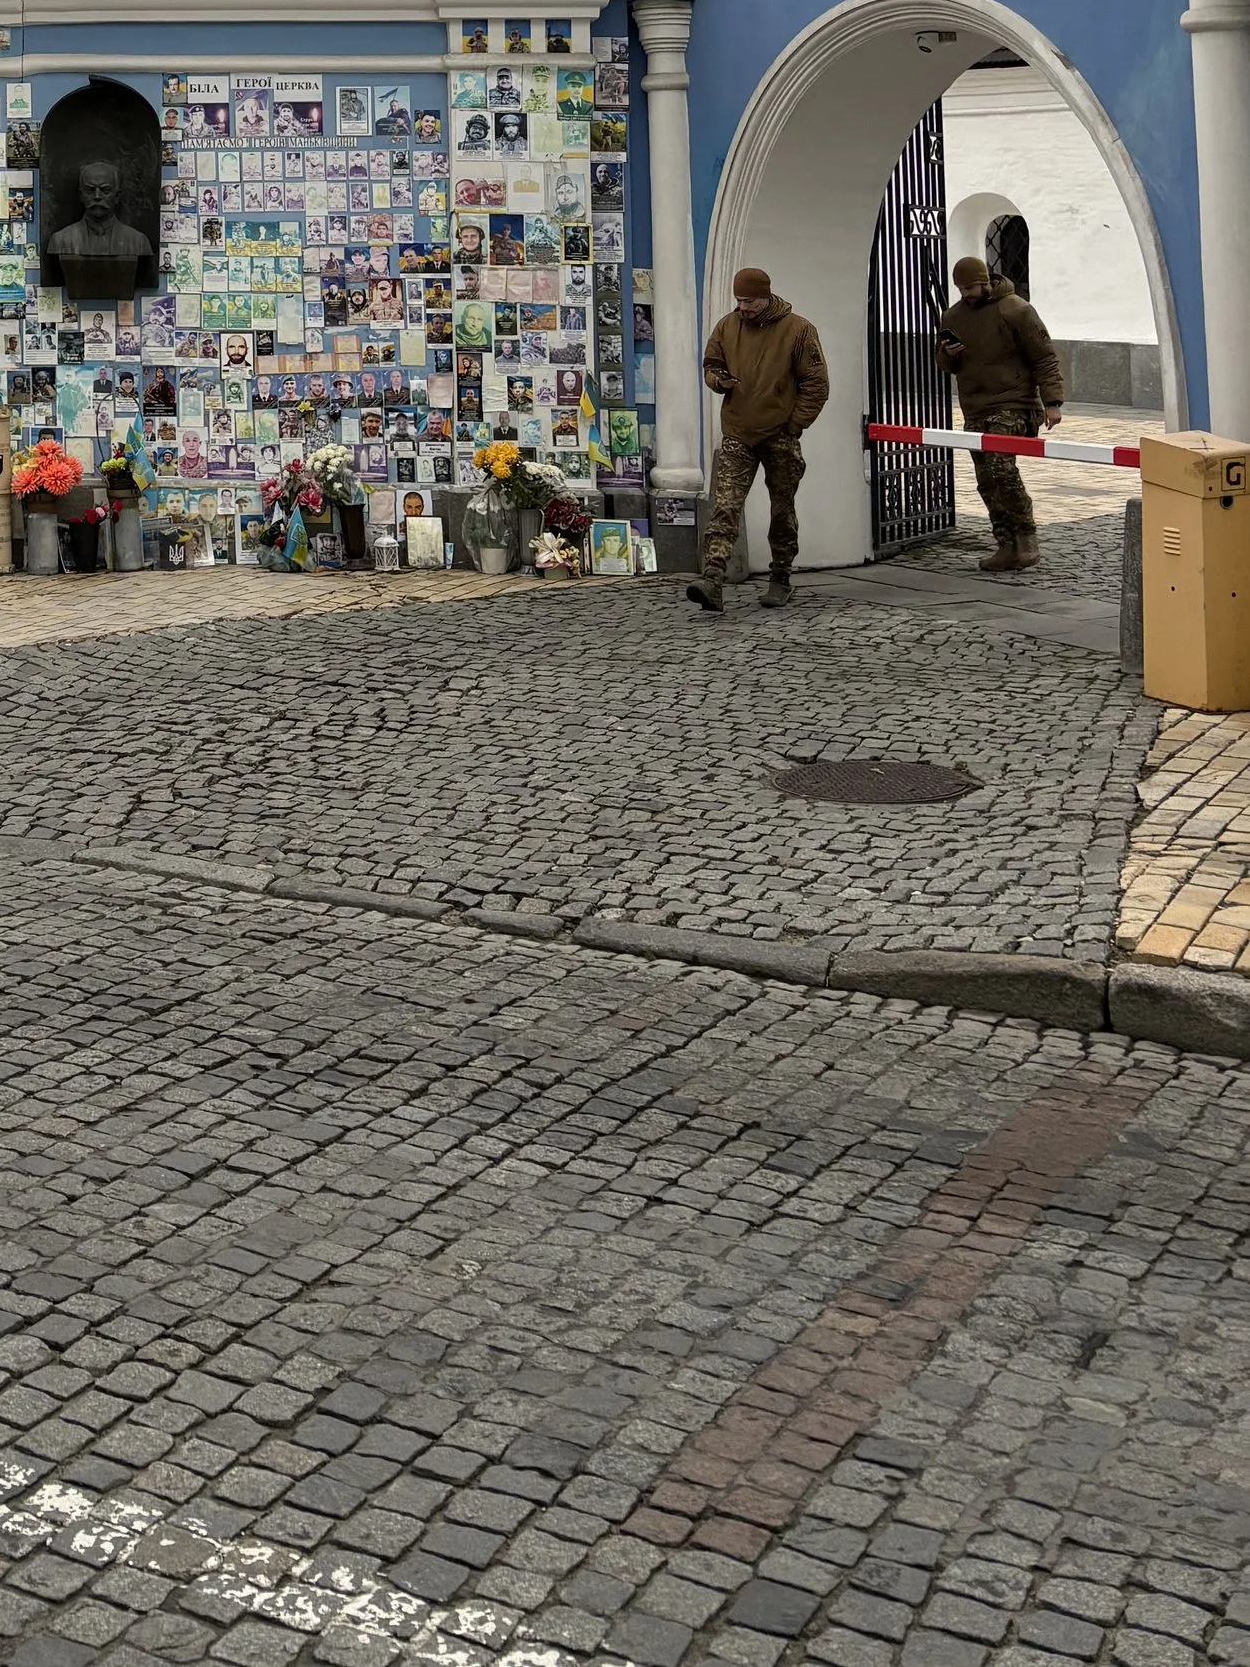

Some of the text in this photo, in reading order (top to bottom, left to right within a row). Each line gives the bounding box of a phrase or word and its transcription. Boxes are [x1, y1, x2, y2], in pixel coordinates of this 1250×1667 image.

[236, 77, 272, 88] ГЕРОЇ
[276, 81, 320, 92] ЦЕРКВА
[189, 83, 219, 94] БІЛА
